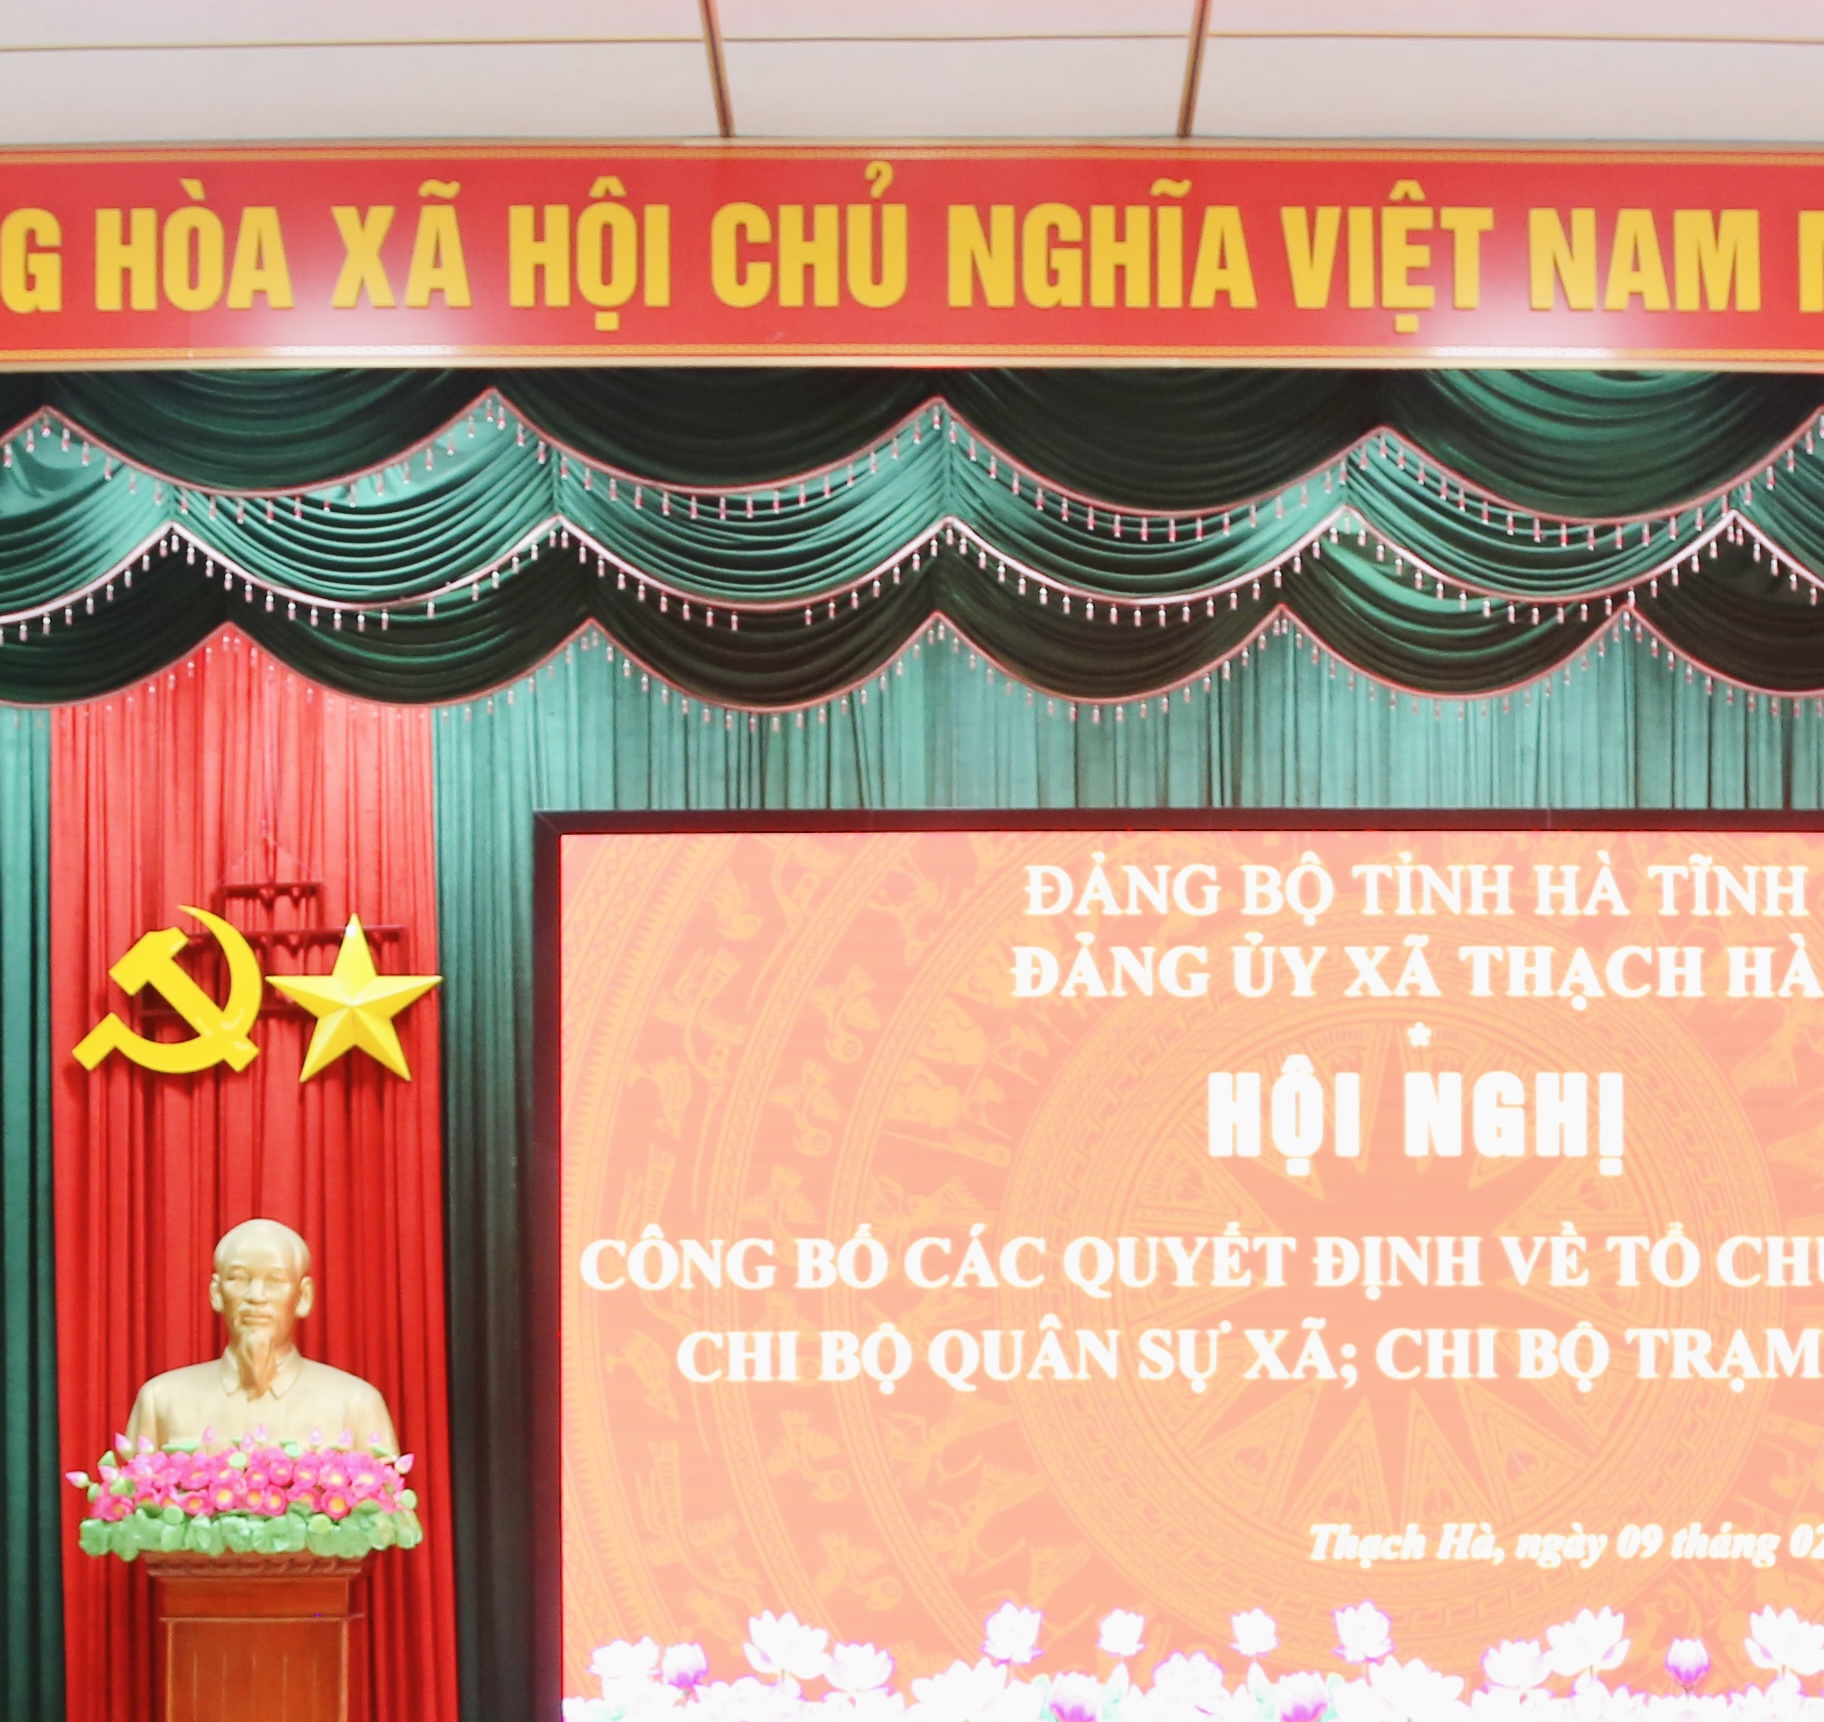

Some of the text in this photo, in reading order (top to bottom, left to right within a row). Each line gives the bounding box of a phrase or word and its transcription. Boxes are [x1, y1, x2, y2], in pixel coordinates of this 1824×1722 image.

[97, 180, 292, 310] HÒA
[334, 181, 470, 306] XÃ
[510, 177, 670, 330] HỘI
[712, 161, 907, 311] CHỦ
[949, 180, 1256, 309] NGHĨA
[1282, 181, 1493, 332] VIỆT
[1530, 209, 1760, 311] NAM
[1026, 850, 1808, 926] ĐẢNG BỘ TỈNH HÀ TĨNH
[1011, 932, 1823, 1010] ĐẢNG ỦY XÃ THẠCH HÀ
[1208, 1055, 1623, 1176] HỘI NGHỊ
[580, 1224, 775, 1290] CÔNG
[796, 1223, 889, 1288] BỐ
[904, 1224, 1046, 1288] CÁC
[1063, 1222, 1296, 1298] QUYẾT
[1313, 1237, 1480, 1300] ĐỊNH
[1501, 1222, 1589, 1286] VỀ
[1606, 1223, 1700, 1286] TỔ
[677, 1331, 798, 1382] CHI
[820, 1323, 912, 1394] BỘ
[928, 1314, 1119, 1391] QUÂN
[1139, 1321, 1231, 1393] SỰ
[1245, 1318, 1357, 1388] XÃ;
[1376, 1328, 1496, 1379] CHI
[1519, 1322, 1610, 1392] BỘ
[1625, 1329, 1821, 1392] TRẠM
[1311, 1523, 1426, 1568] Thạch
[1437, 1523, 1505, 1563] Hà,
[1516, 1523, 1608, 1568] ngày
[1617, 1524, 1663, 1558] 09
[1671, 1522, 1780, 1567] tháng
